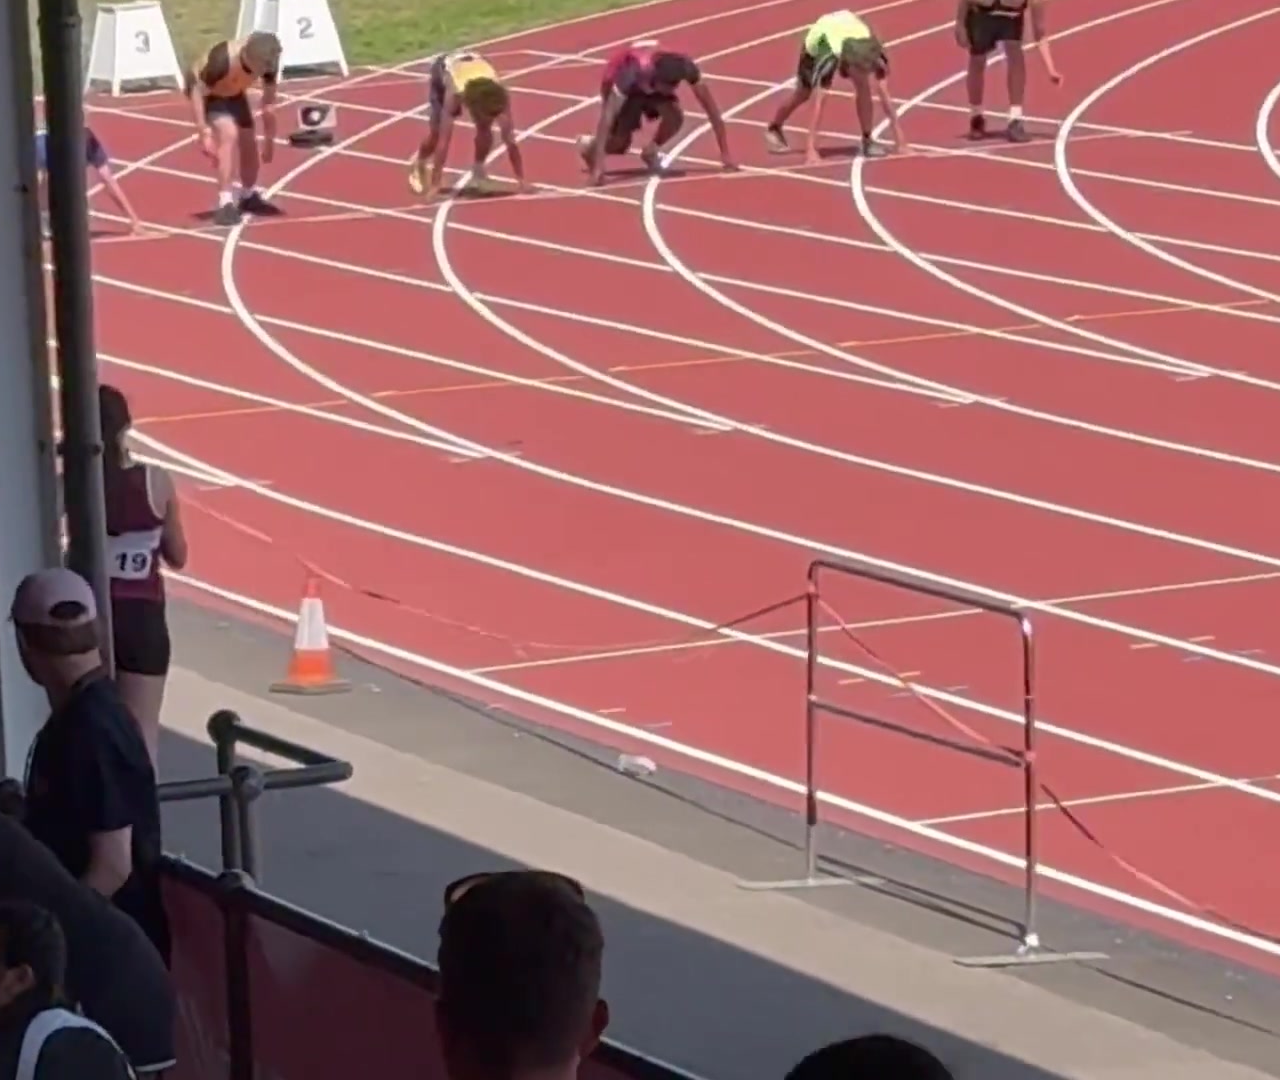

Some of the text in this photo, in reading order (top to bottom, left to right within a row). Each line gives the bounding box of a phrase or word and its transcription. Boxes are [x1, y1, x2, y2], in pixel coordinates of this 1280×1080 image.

[296, 16, 315, 40] 2
[135, 30, 150, 53] 3
[116, 551, 148, 573] 19
